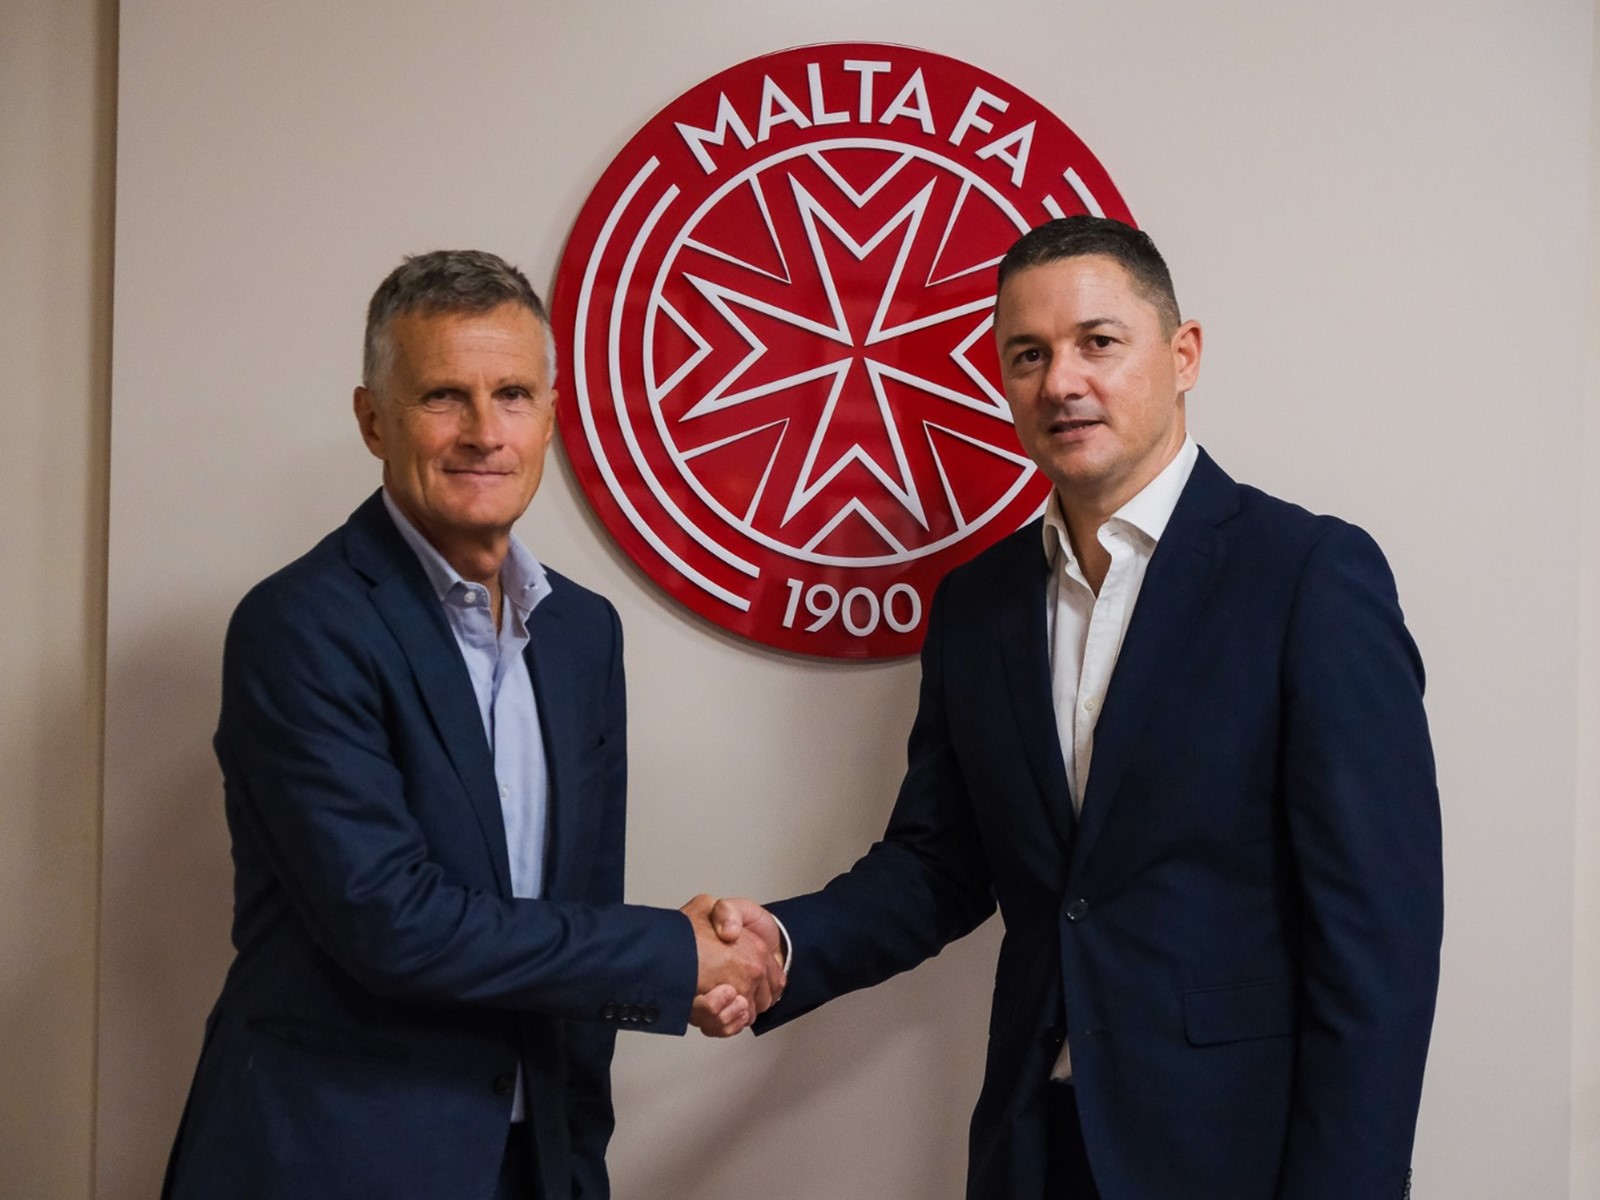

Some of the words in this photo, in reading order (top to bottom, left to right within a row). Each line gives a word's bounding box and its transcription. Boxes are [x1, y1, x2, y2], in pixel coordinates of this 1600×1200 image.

[674, 59, 936, 175] MALTA
[948, 86, 1037, 188] FA
[782, 577, 922, 637] 1900
